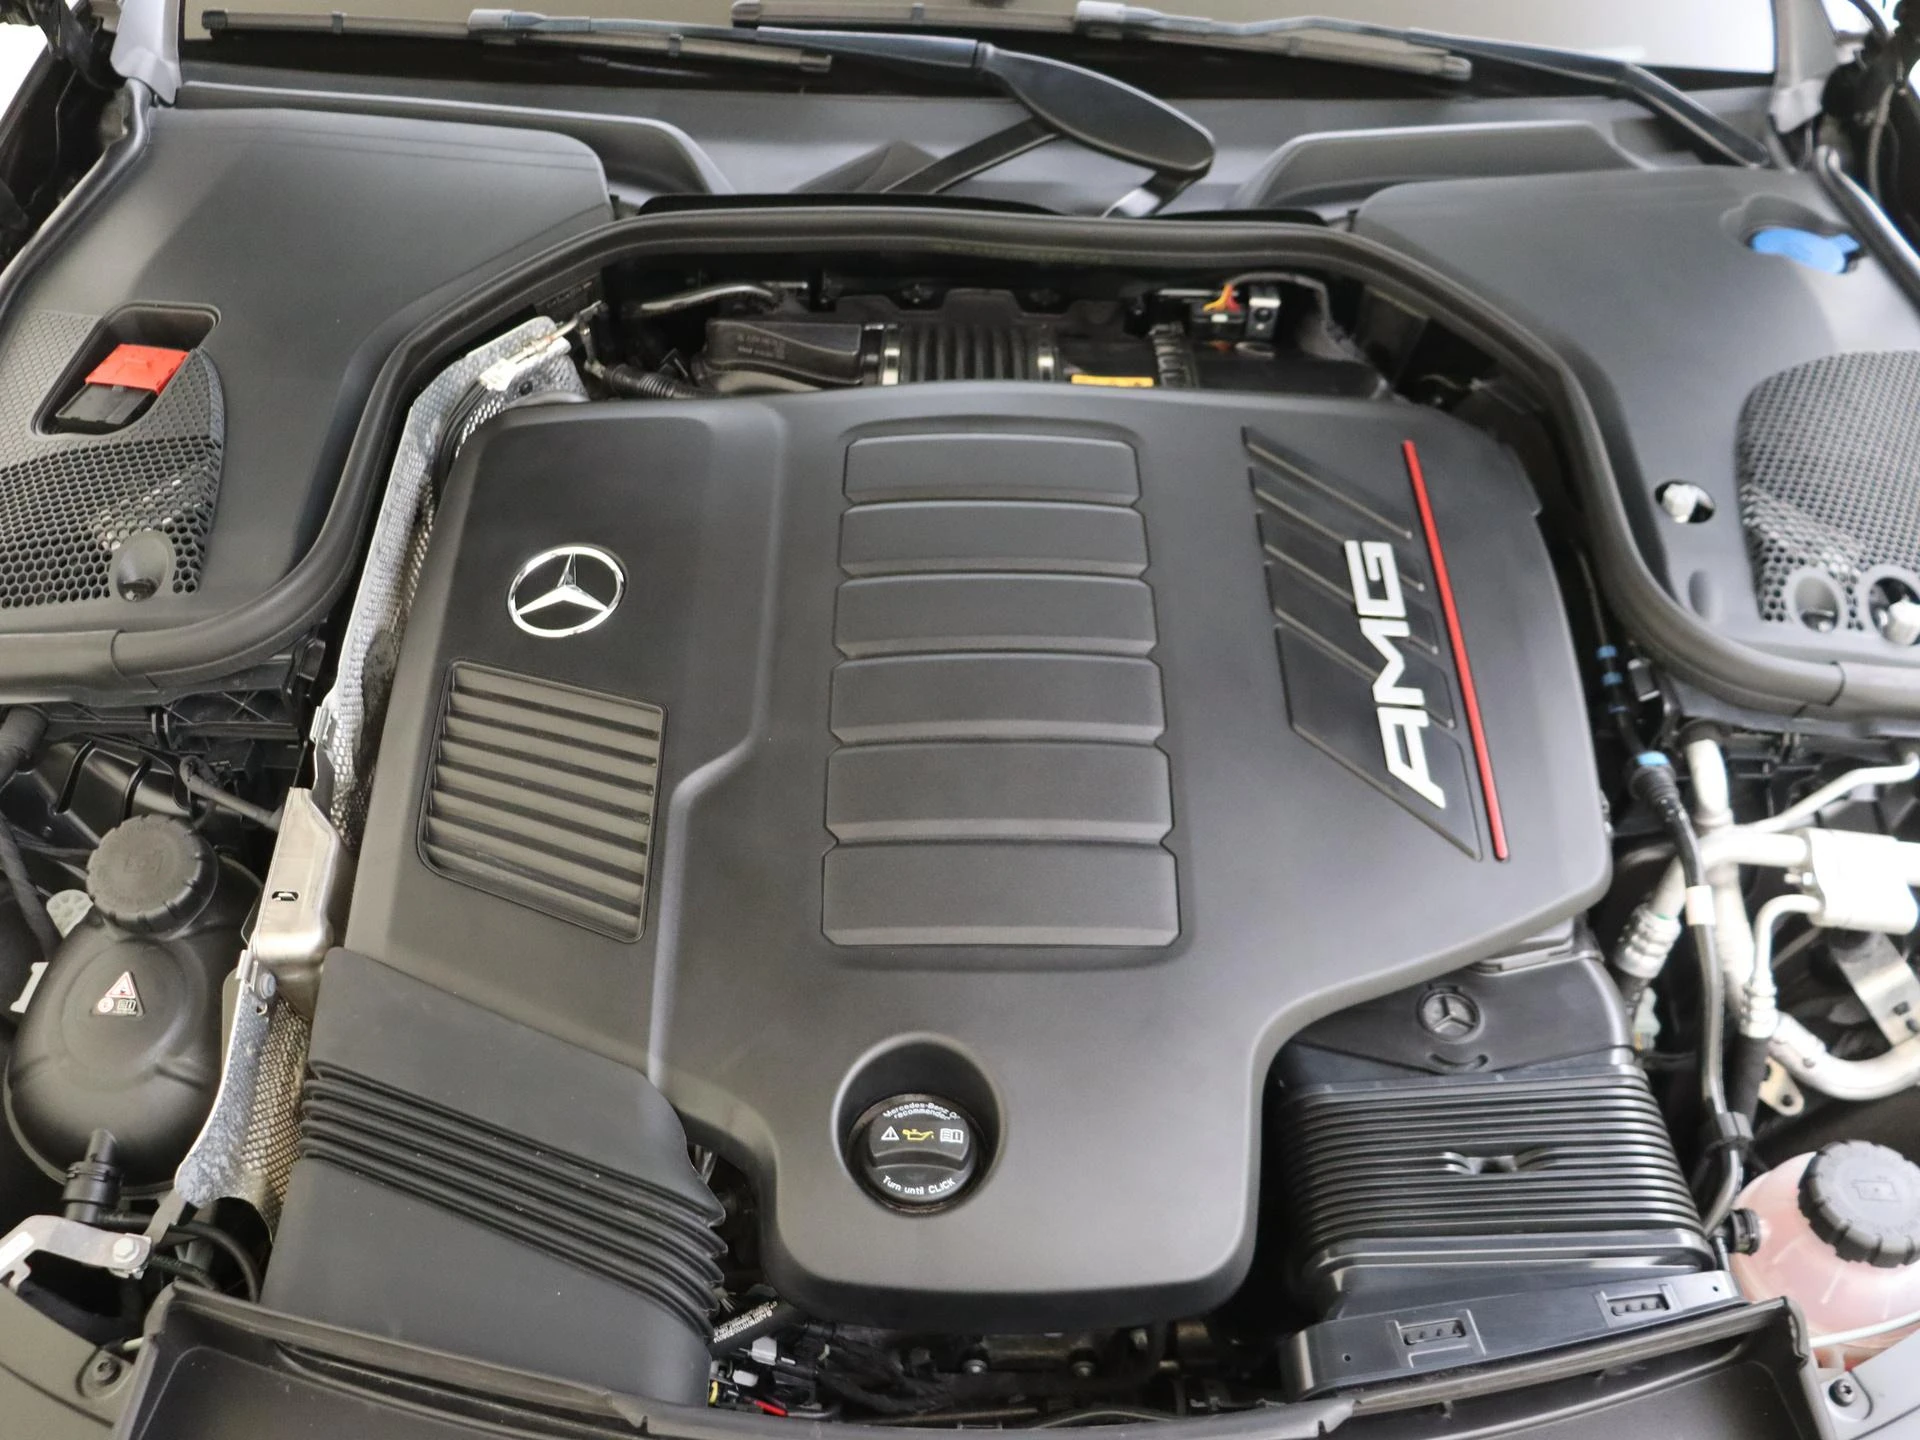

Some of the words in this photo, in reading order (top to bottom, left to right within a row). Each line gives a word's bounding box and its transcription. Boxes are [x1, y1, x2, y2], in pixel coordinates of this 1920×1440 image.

[1344, 540, 1446, 810] AMG
[883, 1175, 902, 1191] Turn
[904, 1186, 924, 1195] until
[928, 1177, 956, 1194] CLICK
